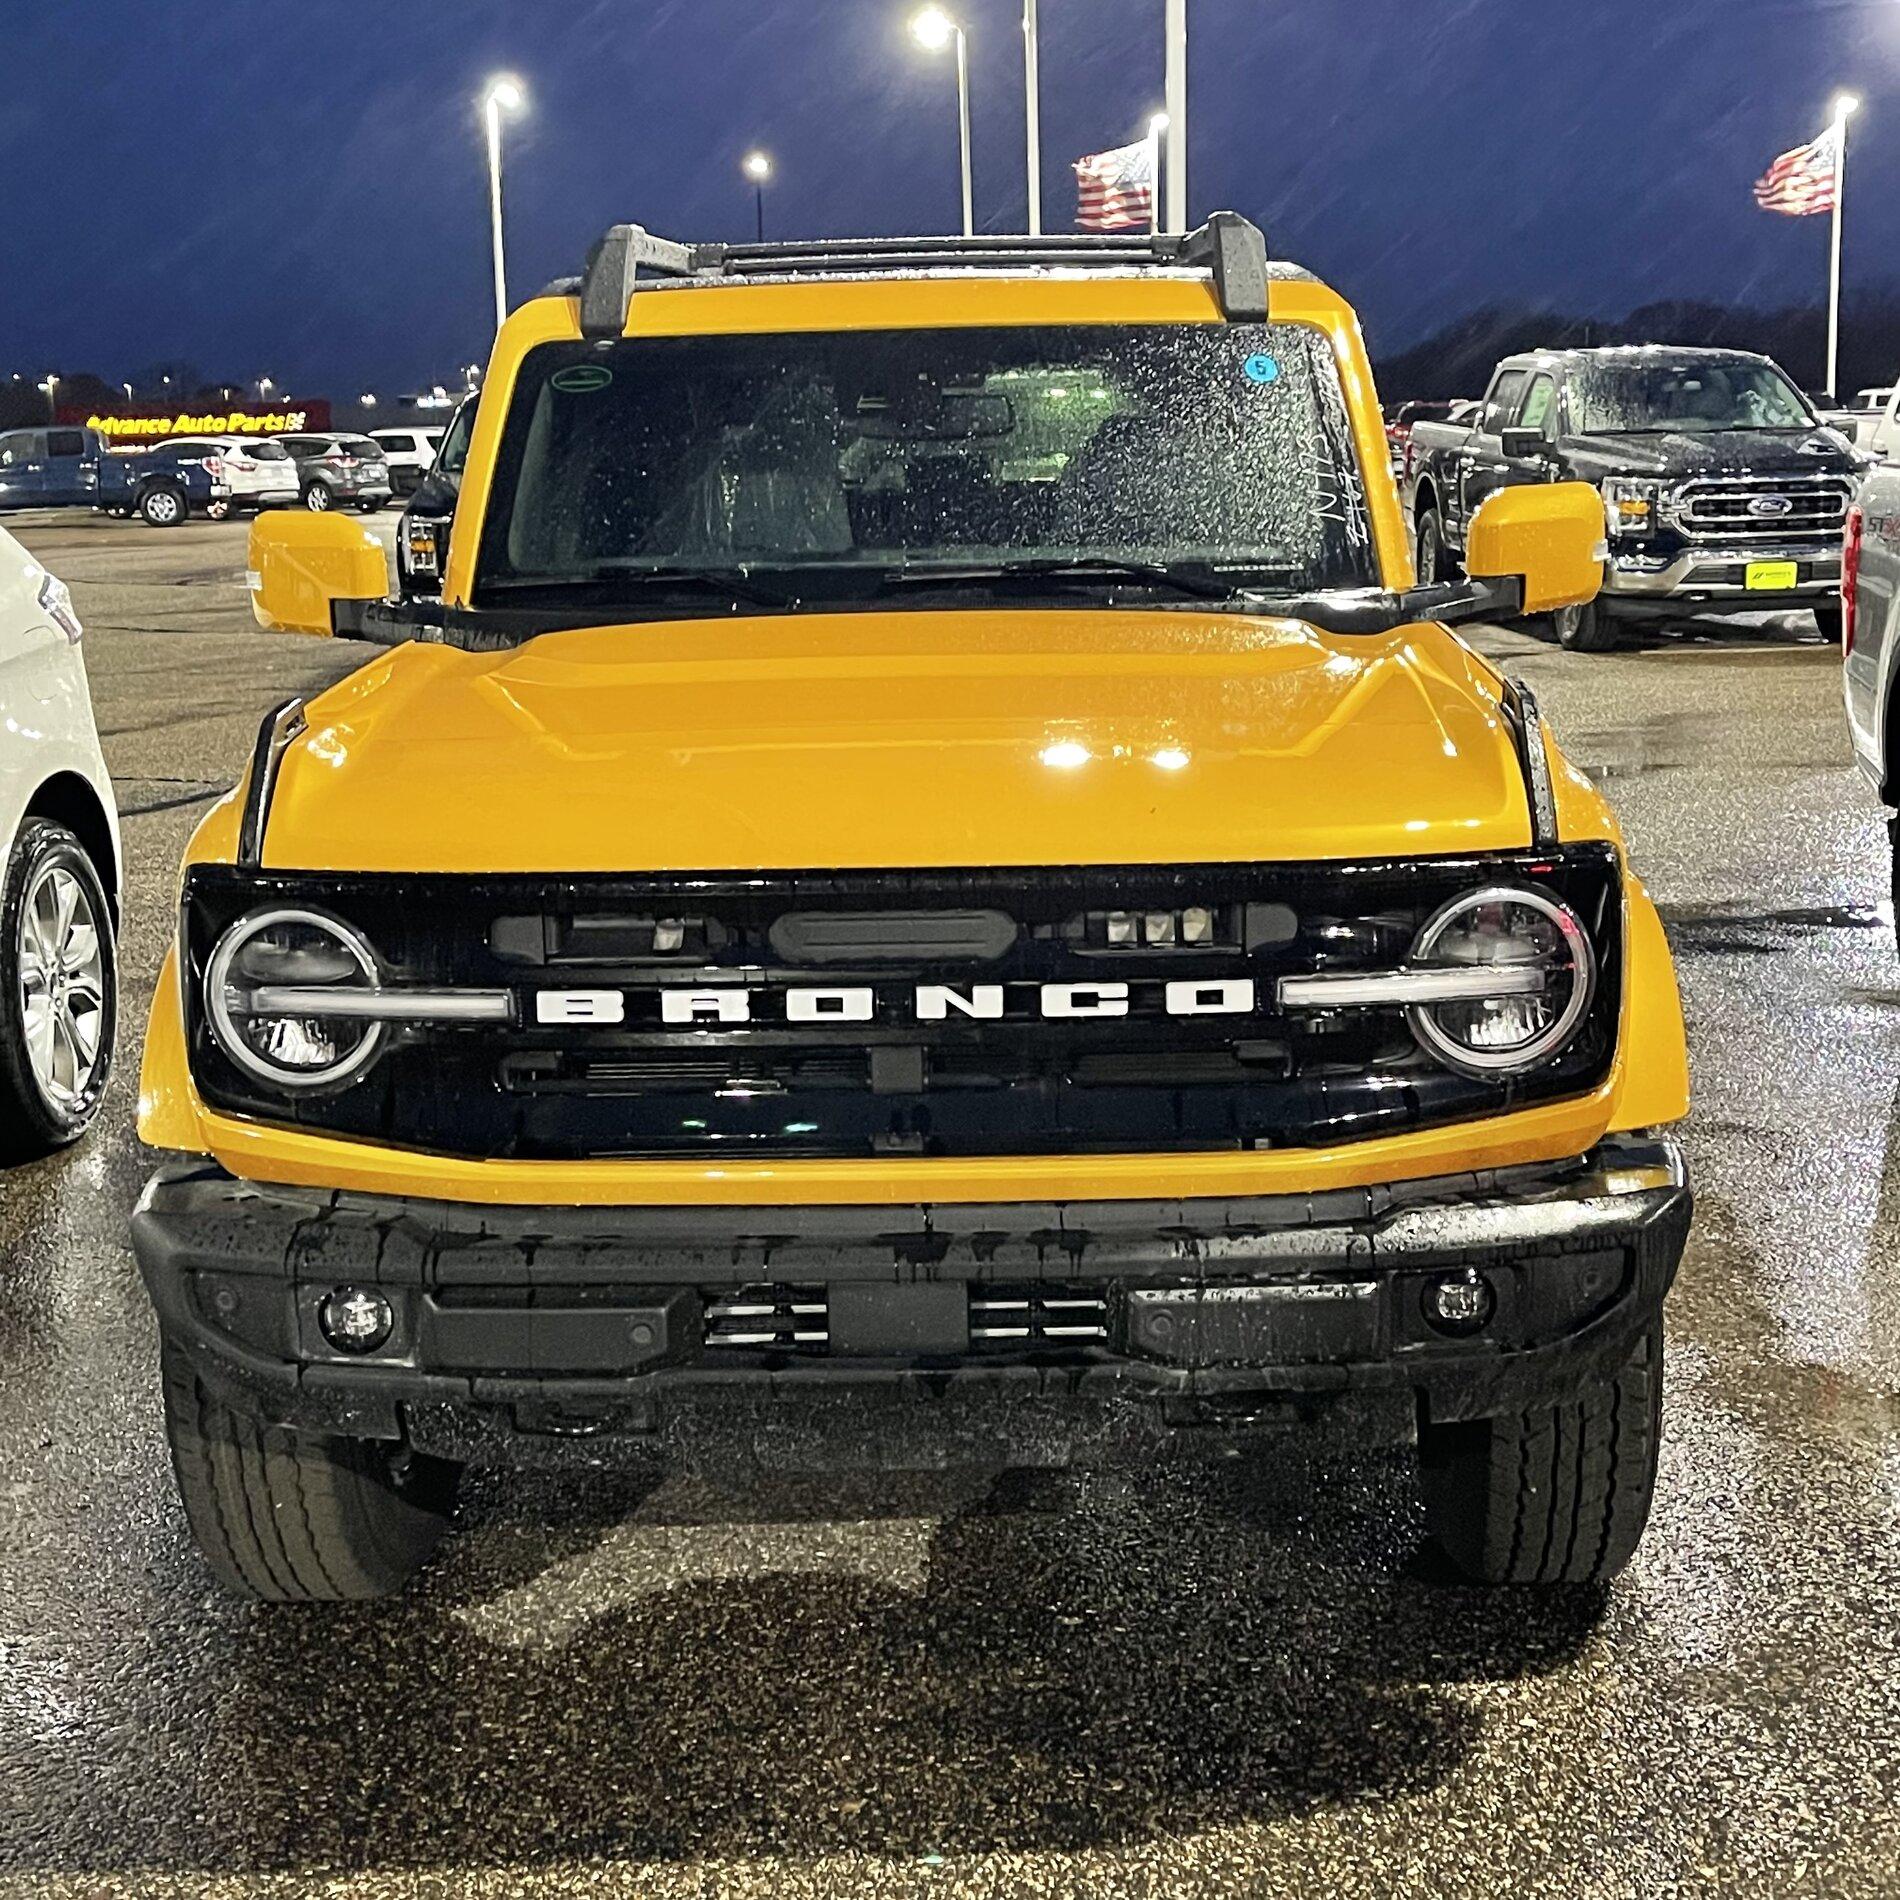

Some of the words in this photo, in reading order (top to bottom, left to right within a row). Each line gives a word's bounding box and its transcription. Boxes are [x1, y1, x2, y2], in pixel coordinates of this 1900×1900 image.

[1254, 360, 1267, 375] 5
[86, 415, 172, 435] Advance
[171, 414, 227, 433] Auto
[227, 412, 286, 432] Parts
[536, 979, 1254, 1023] BRONCO
